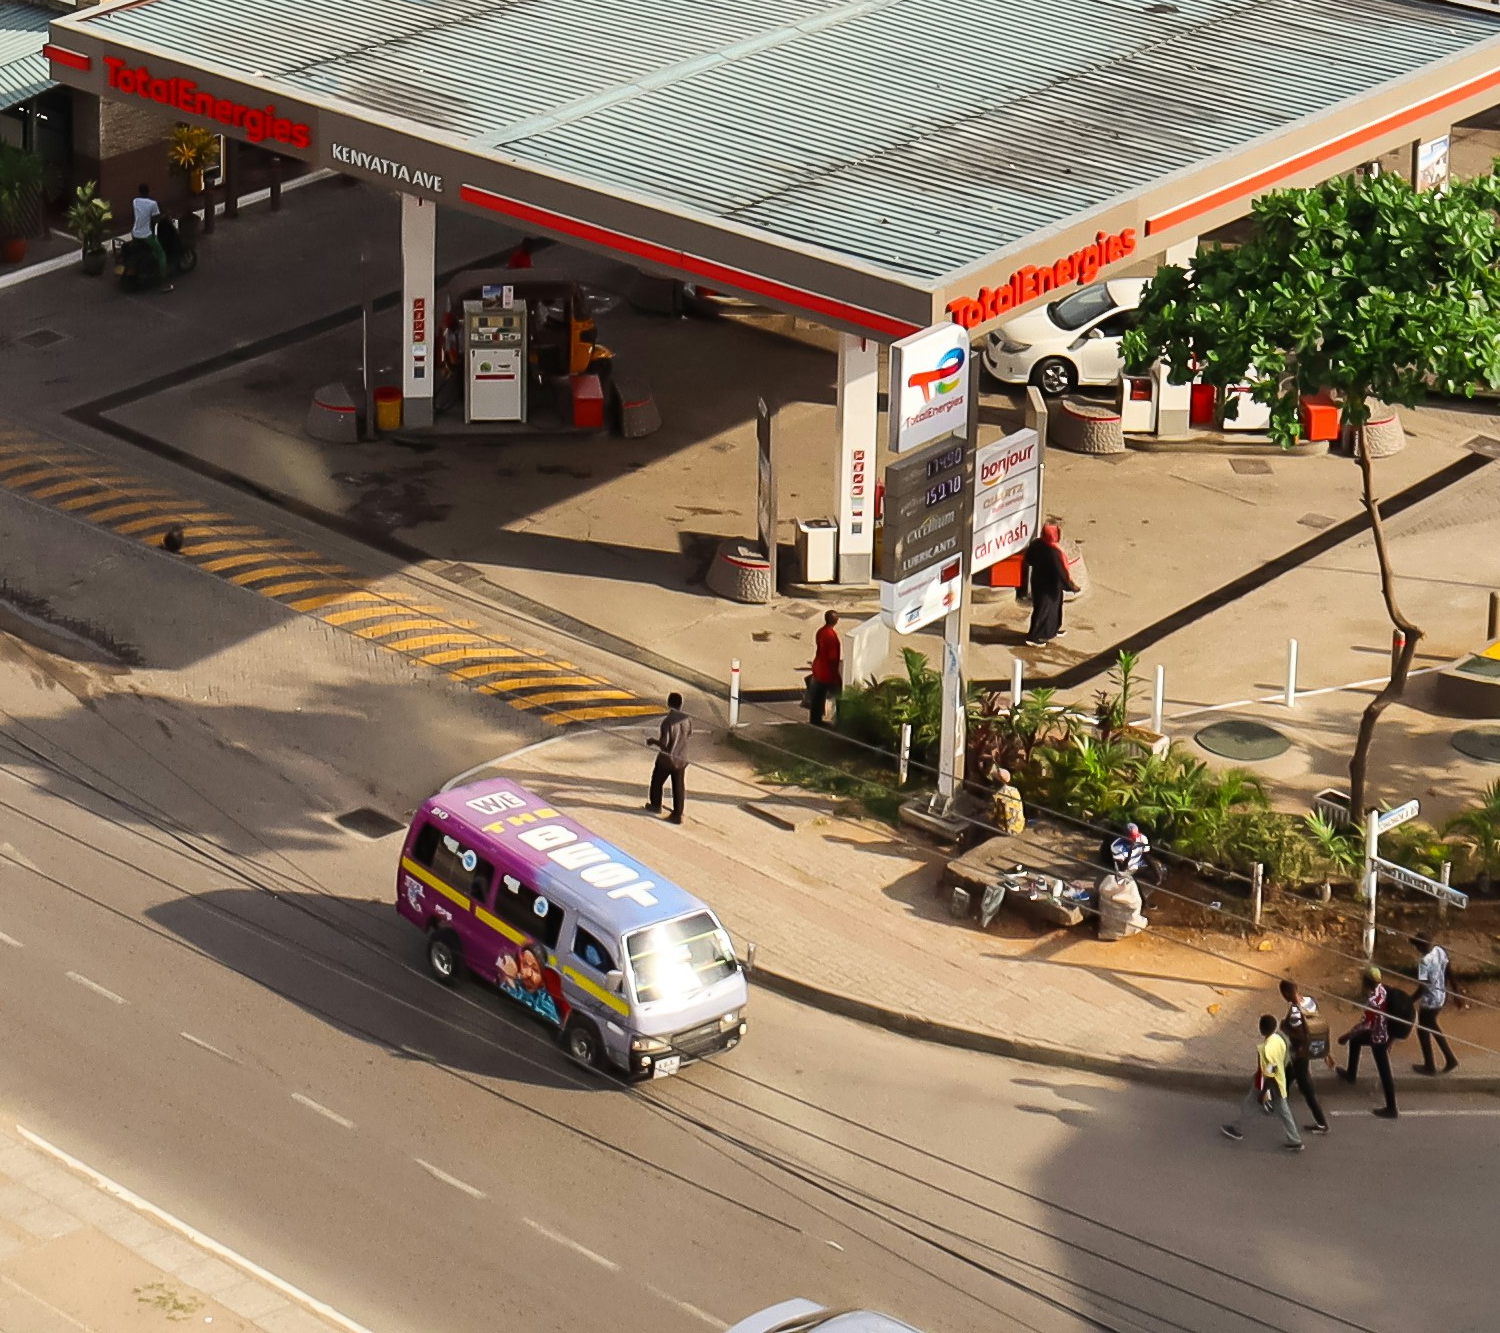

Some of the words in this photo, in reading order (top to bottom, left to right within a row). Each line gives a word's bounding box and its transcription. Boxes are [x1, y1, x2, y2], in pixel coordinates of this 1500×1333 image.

[103, 55, 311, 150] TotalEnergies
[331, 142, 410, 185] KENYATTA
[413, 171, 444, 193] AVE
[945, 228, 1137, 330] TotalEnergies
[905, 395, 964, 429] TotalEnergies
[981, 444, 1035, 481] bonjour
[903, 536, 957, 571] LUBRICANTS
[974, 539, 993, 560] car
[995, 520, 1028, 550] wash
[466, 791, 527, 815] WE
[481, 808, 561, 834] THE
[517, 824, 660, 908] BEST
